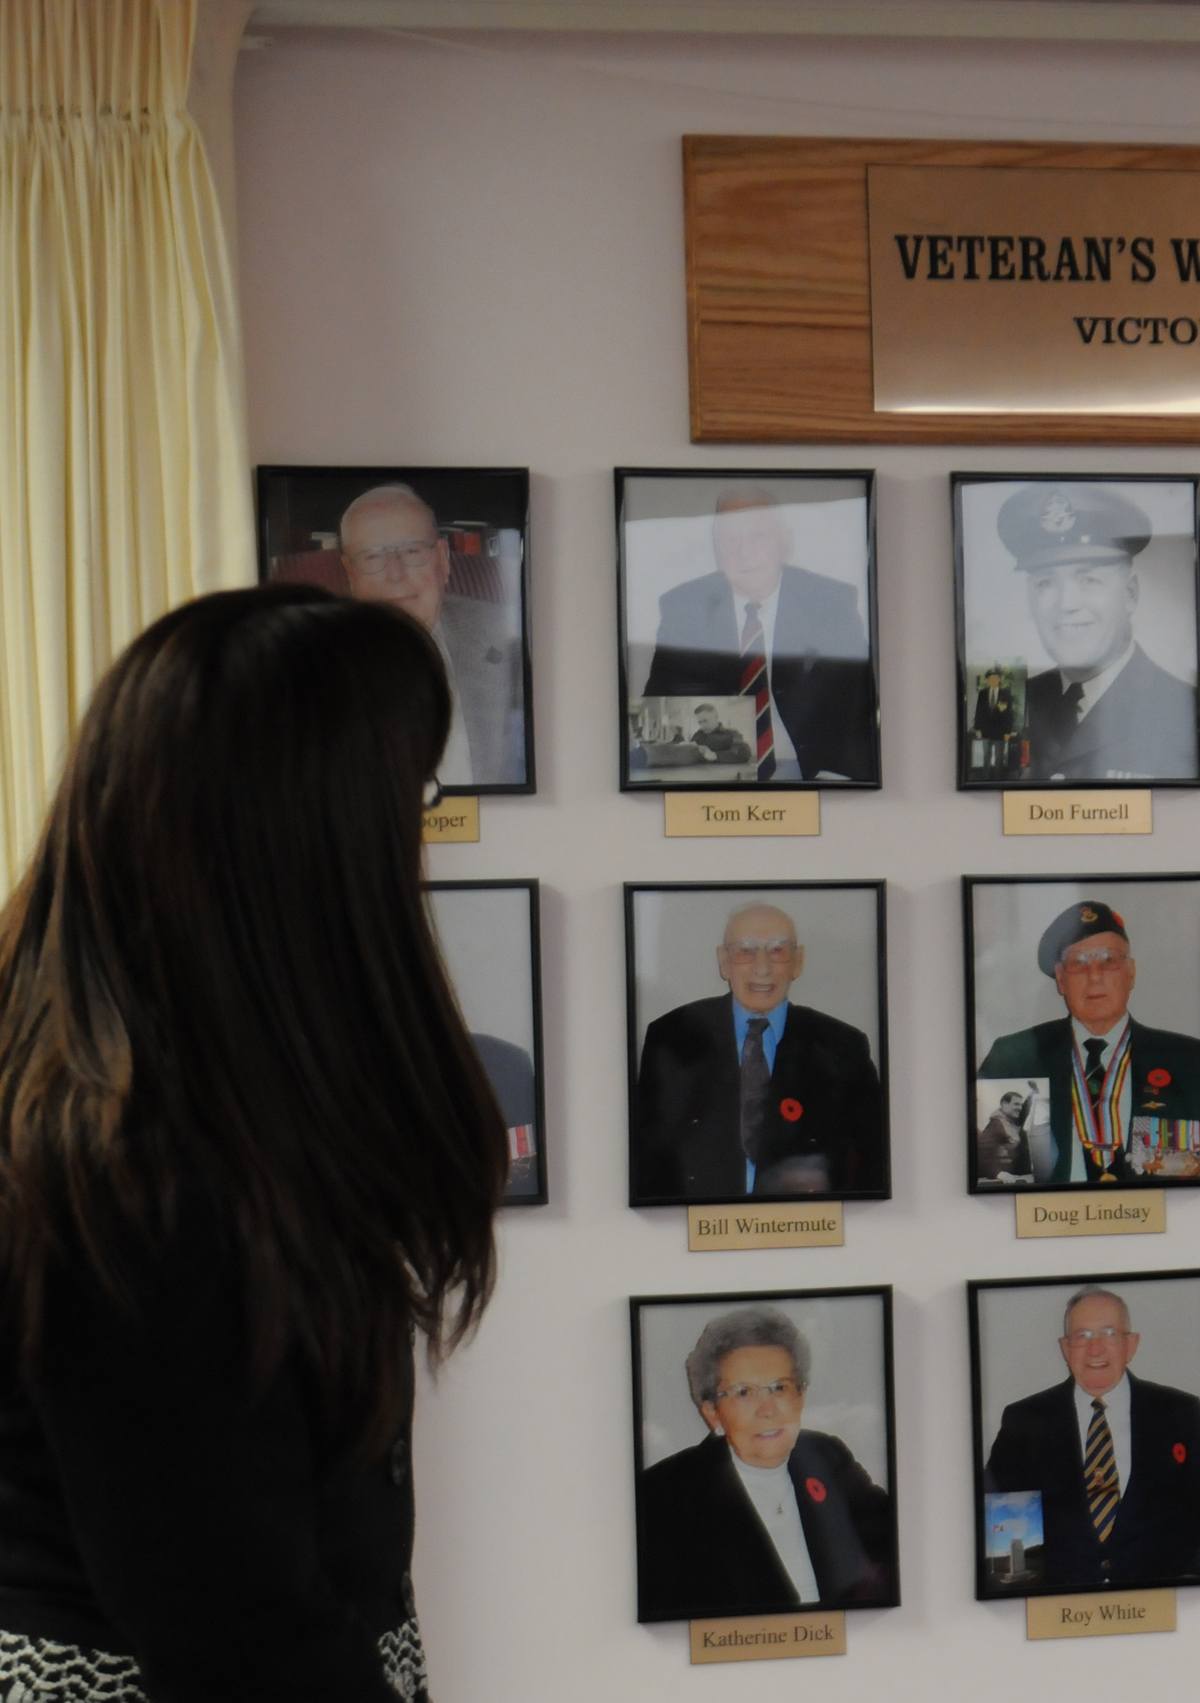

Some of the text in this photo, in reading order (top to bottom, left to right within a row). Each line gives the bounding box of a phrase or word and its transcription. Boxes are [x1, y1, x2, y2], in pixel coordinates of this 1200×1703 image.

[895, 234, 1157, 283] VETERAN'S
[702, 805, 786, 821] Tom Kerr
[1029, 803, 1129, 821] Don Furnell
[1034, 1204, 1151, 1224] Doug Lindsay
[698, 1218, 836, 1235] Bill Wintermute
[1061, 1605, 1146, 1626] Roy White
[703, 1625, 833, 1648] Katherine Dick
